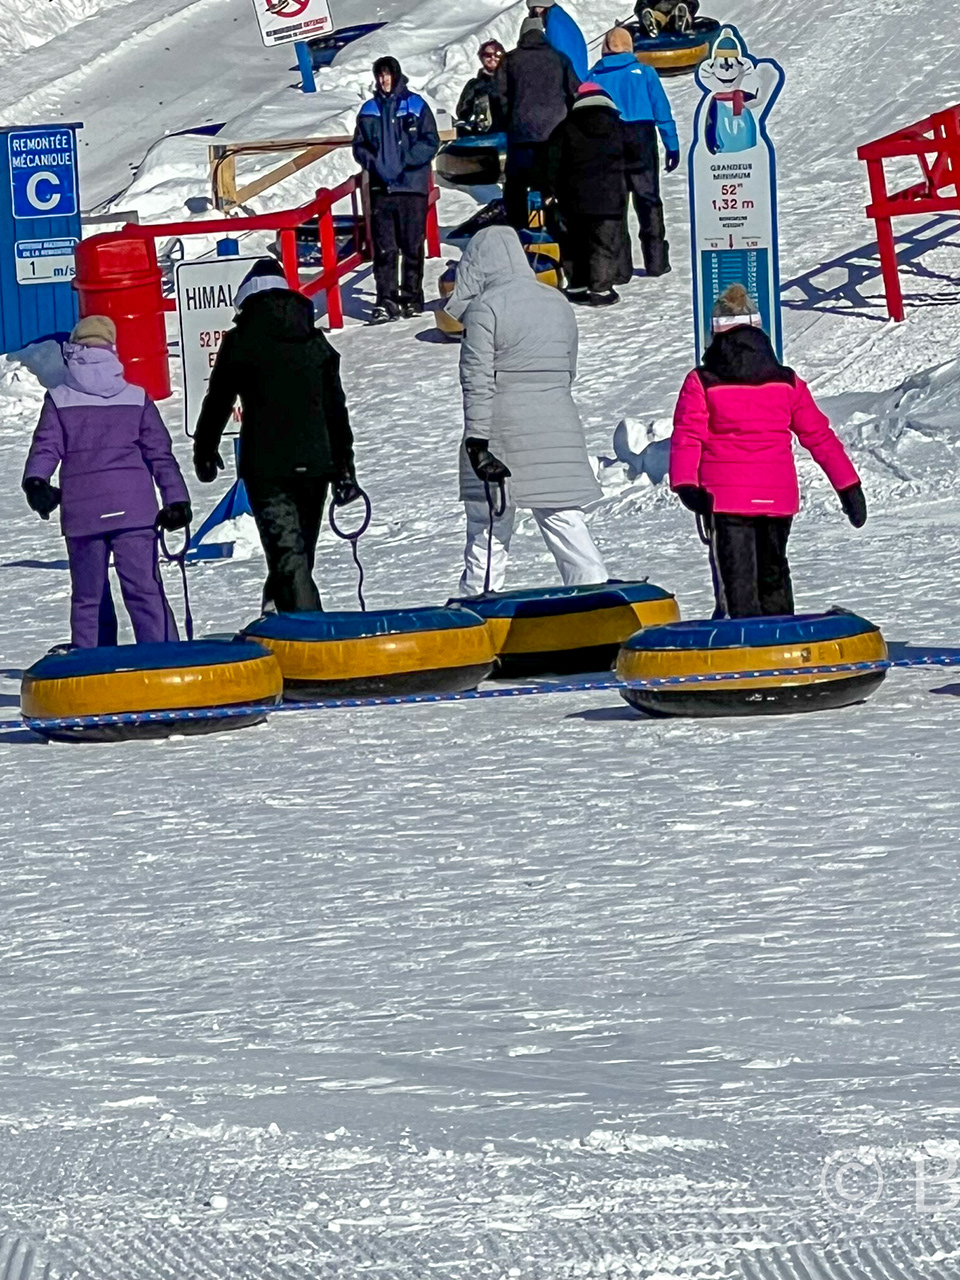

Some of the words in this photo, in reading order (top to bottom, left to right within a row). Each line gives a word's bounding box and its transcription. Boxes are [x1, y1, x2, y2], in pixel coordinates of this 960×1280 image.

[12, 134, 69, 151] REMONTÉE
[12, 153, 72, 168] MÉCANIQUE
[26, 171, 61, 210] C
[712, 198, 738, 211] 1,32
[742, 200, 754, 209] m
[29, 261, 36, 276] 1
[53, 265, 76, 277] m/s
[186, 284, 234, 310] HIMAL
[199, 331, 212, 348] 52
